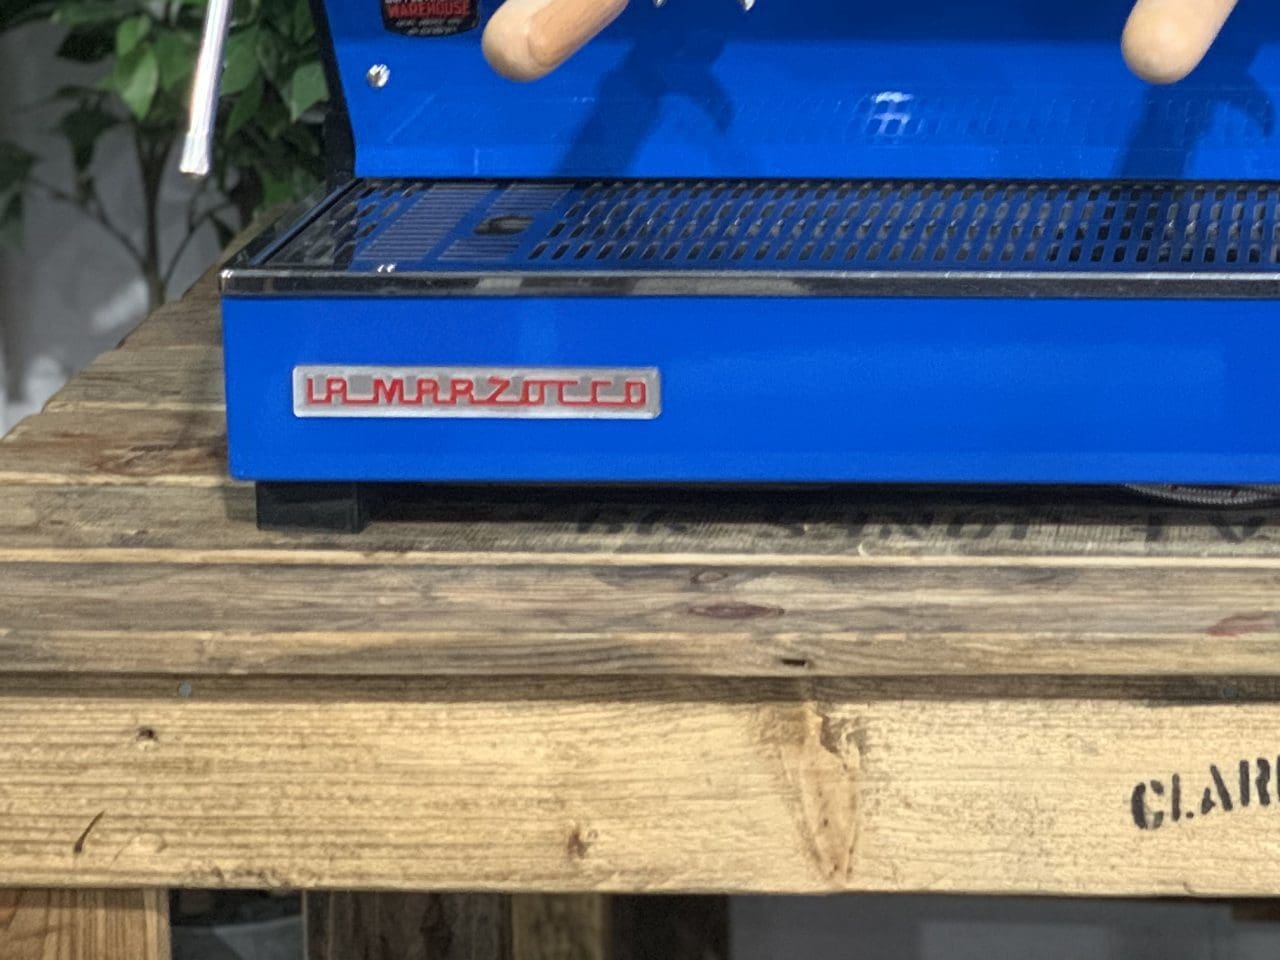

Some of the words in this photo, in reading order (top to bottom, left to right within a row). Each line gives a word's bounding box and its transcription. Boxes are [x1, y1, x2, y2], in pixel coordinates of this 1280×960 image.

[387, 0, 470, 17] WAREHOUSE
[307, 376, 347, 405] LA
[373, 376, 647, 406] MARZOCCO
